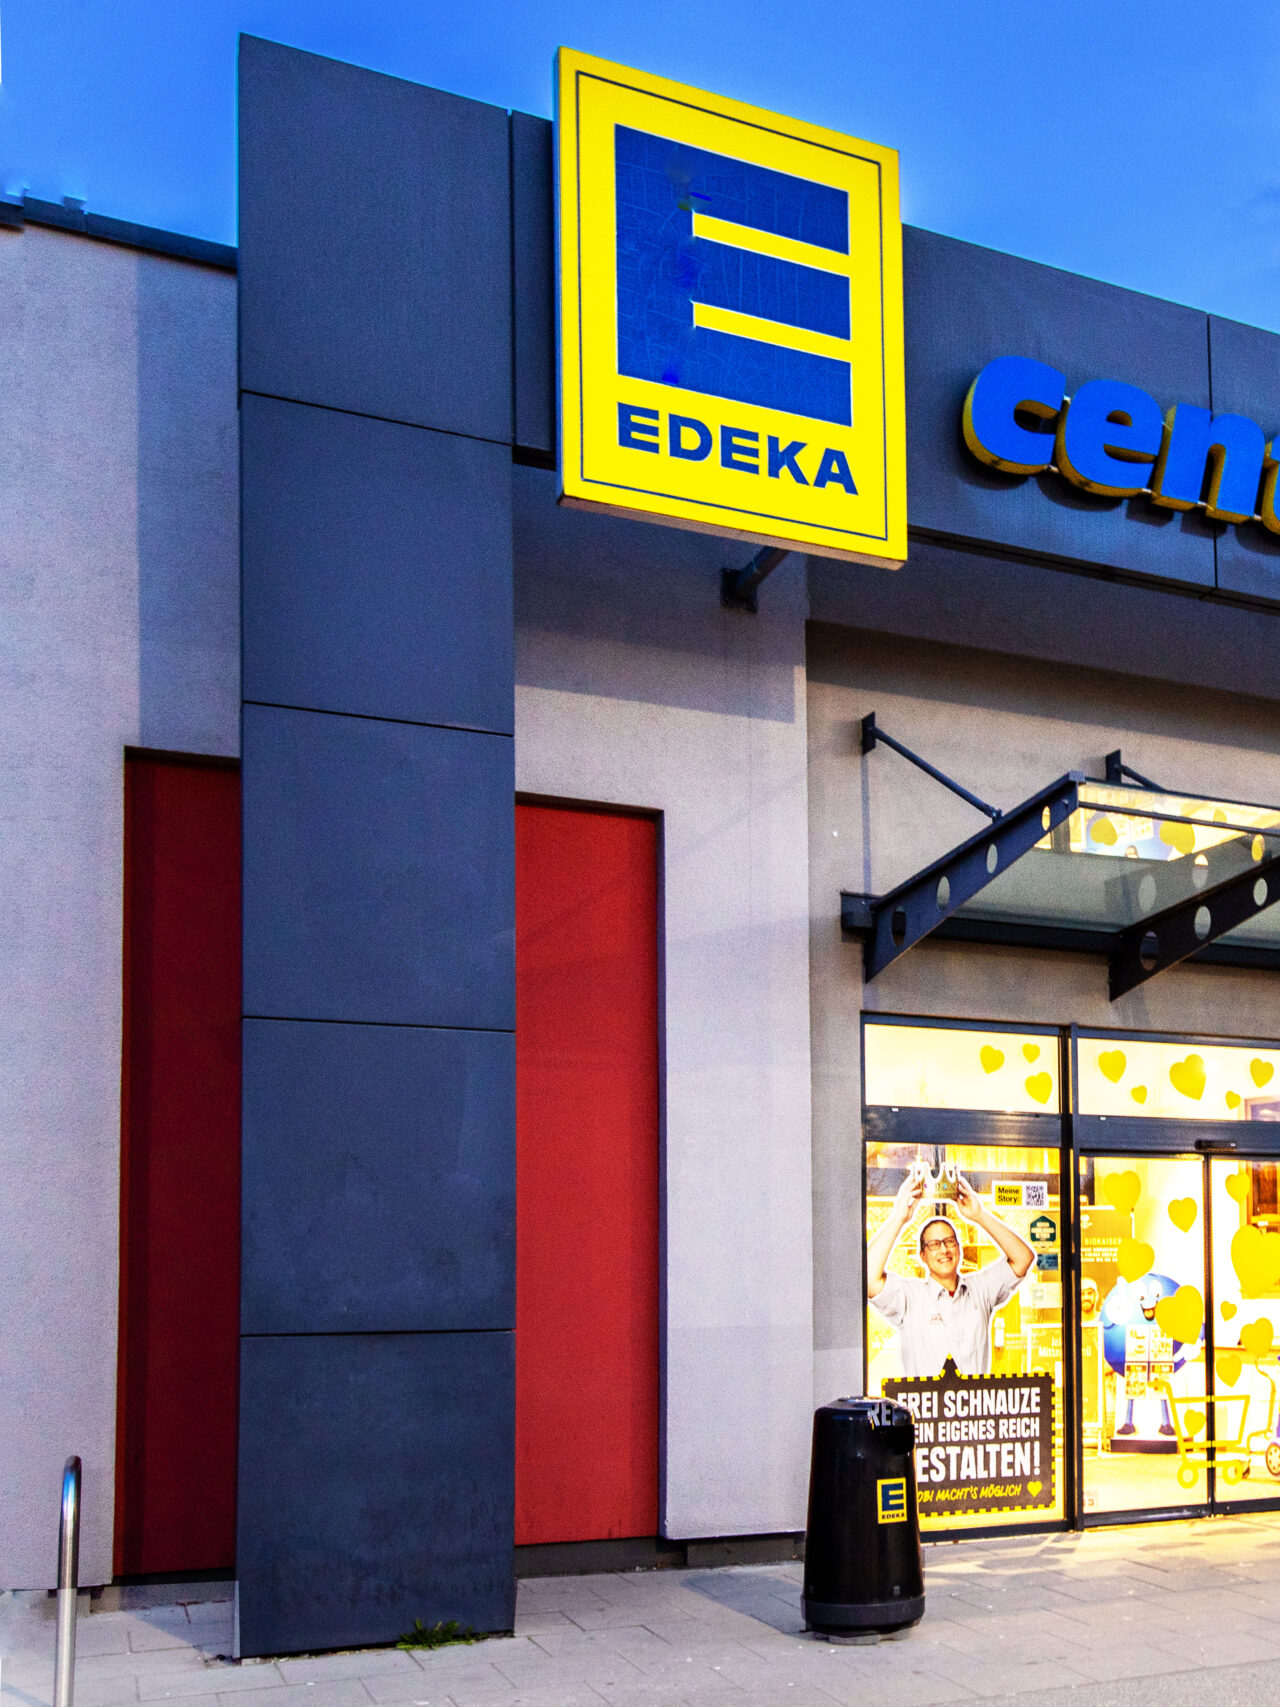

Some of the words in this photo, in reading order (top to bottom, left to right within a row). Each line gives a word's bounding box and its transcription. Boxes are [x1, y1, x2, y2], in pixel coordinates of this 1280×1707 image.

[614, 122, 852, 427] E
[617, 402, 859, 496] EDEKA
[998, 1195, 1020, 1204] Story:
[897, 1390, 939, 1419] FREI
[943, 1387, 1041, 1418] SCHNAUZE
[914, 1422, 935, 1443] EIN
[938, 1419, 996, 1442] EIGENES
[998, 1417, 1040, 1439] REICH
[915, 1440, 1041, 1483] ESTALTEN!
[881, 1482, 904, 1512] E
[935, 1485, 978, 1501] MACHT'S
[979, 1483, 1022, 1499] MÖGLICH
[881, 1512, 905, 1520] EDEKA
